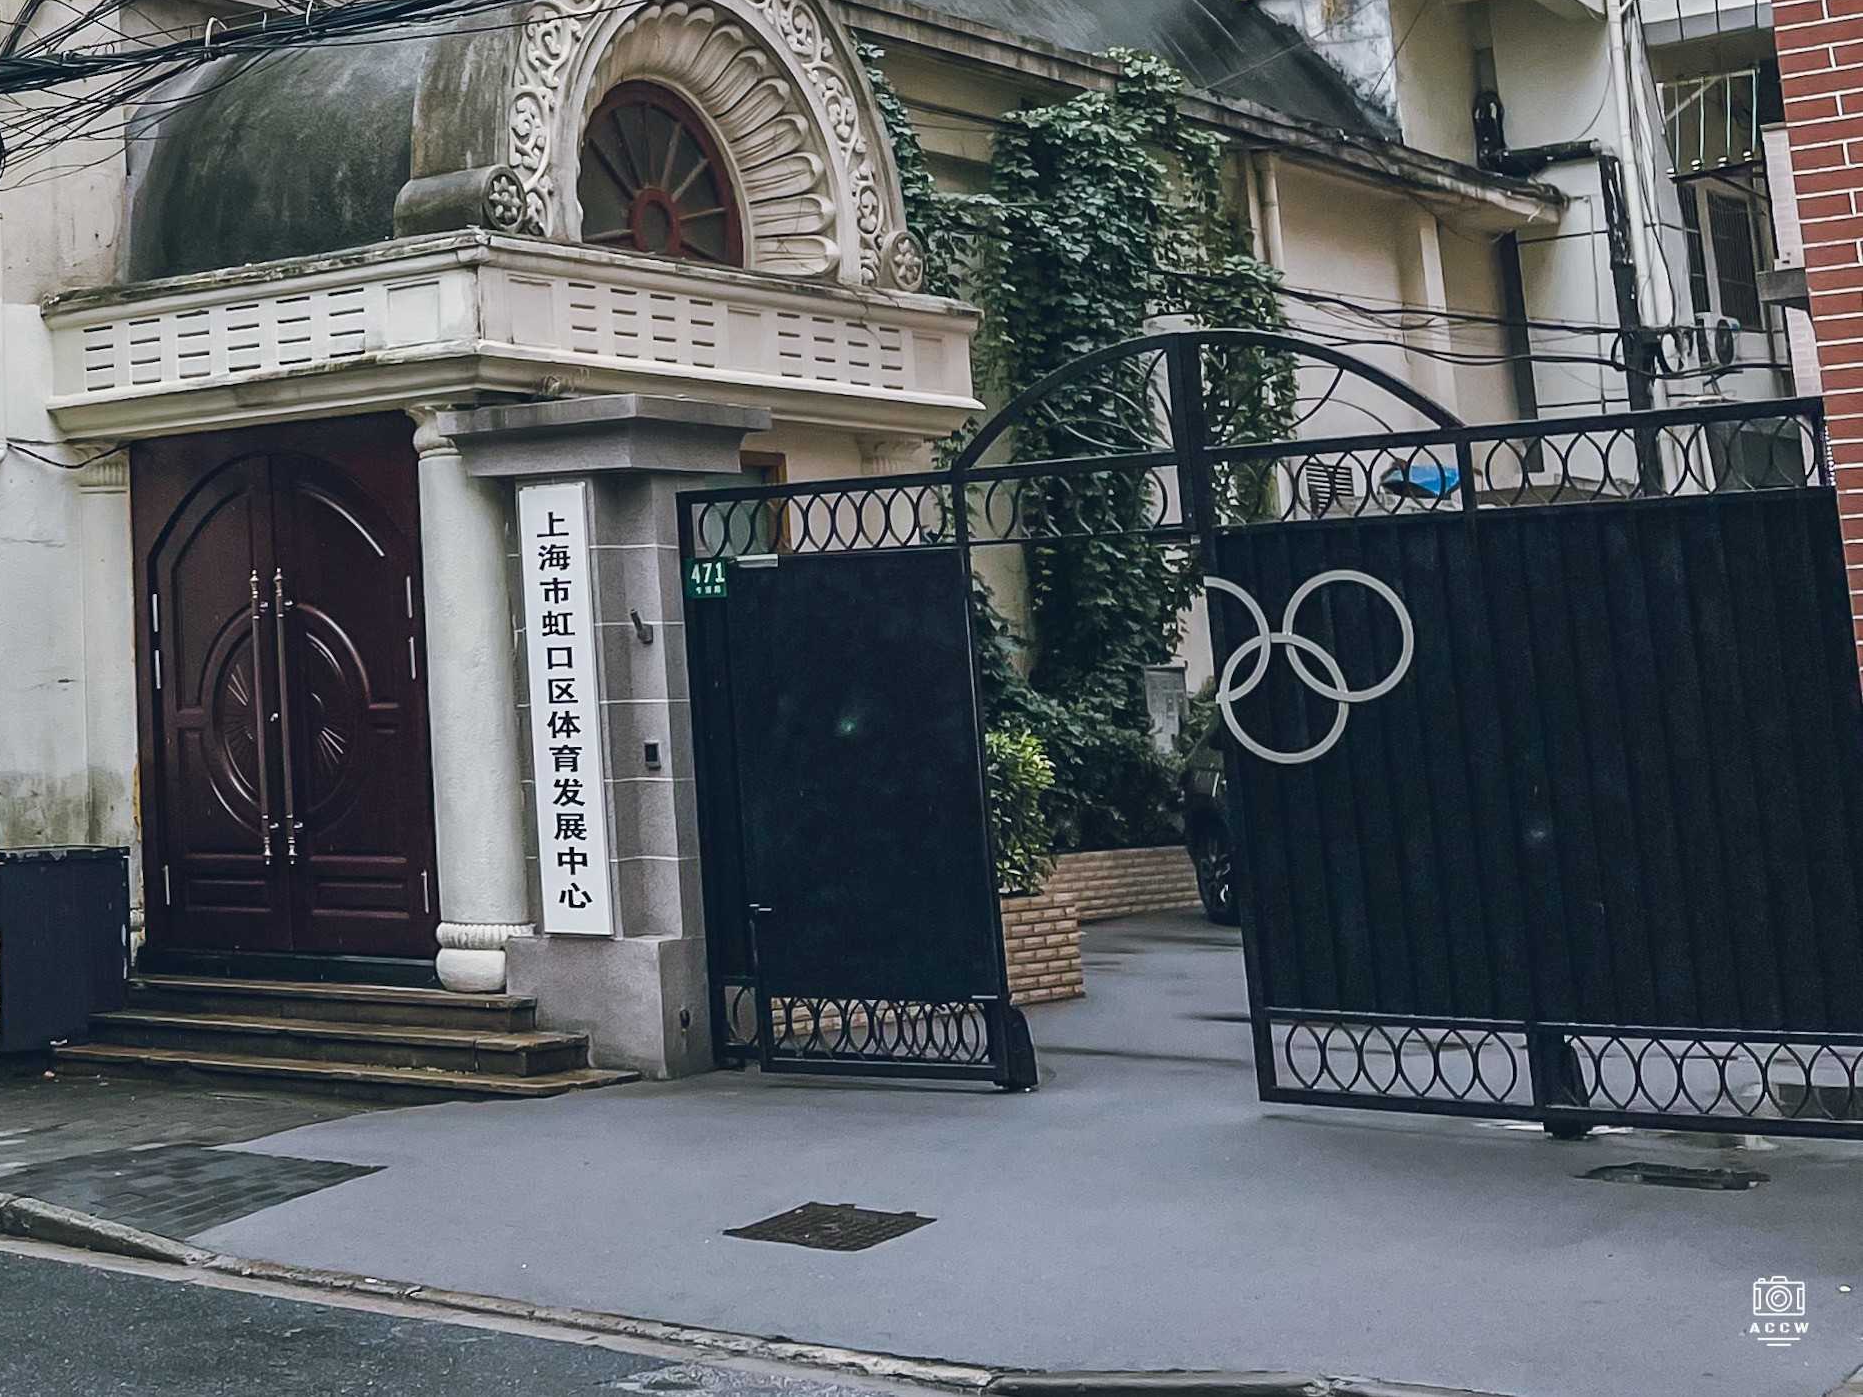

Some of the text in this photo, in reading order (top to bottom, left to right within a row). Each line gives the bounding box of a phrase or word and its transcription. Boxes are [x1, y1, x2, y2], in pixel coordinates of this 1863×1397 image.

[691, 562, 725, 584] 471
[537, 512, 592, 909] 上海市虹口区体育发展中心
